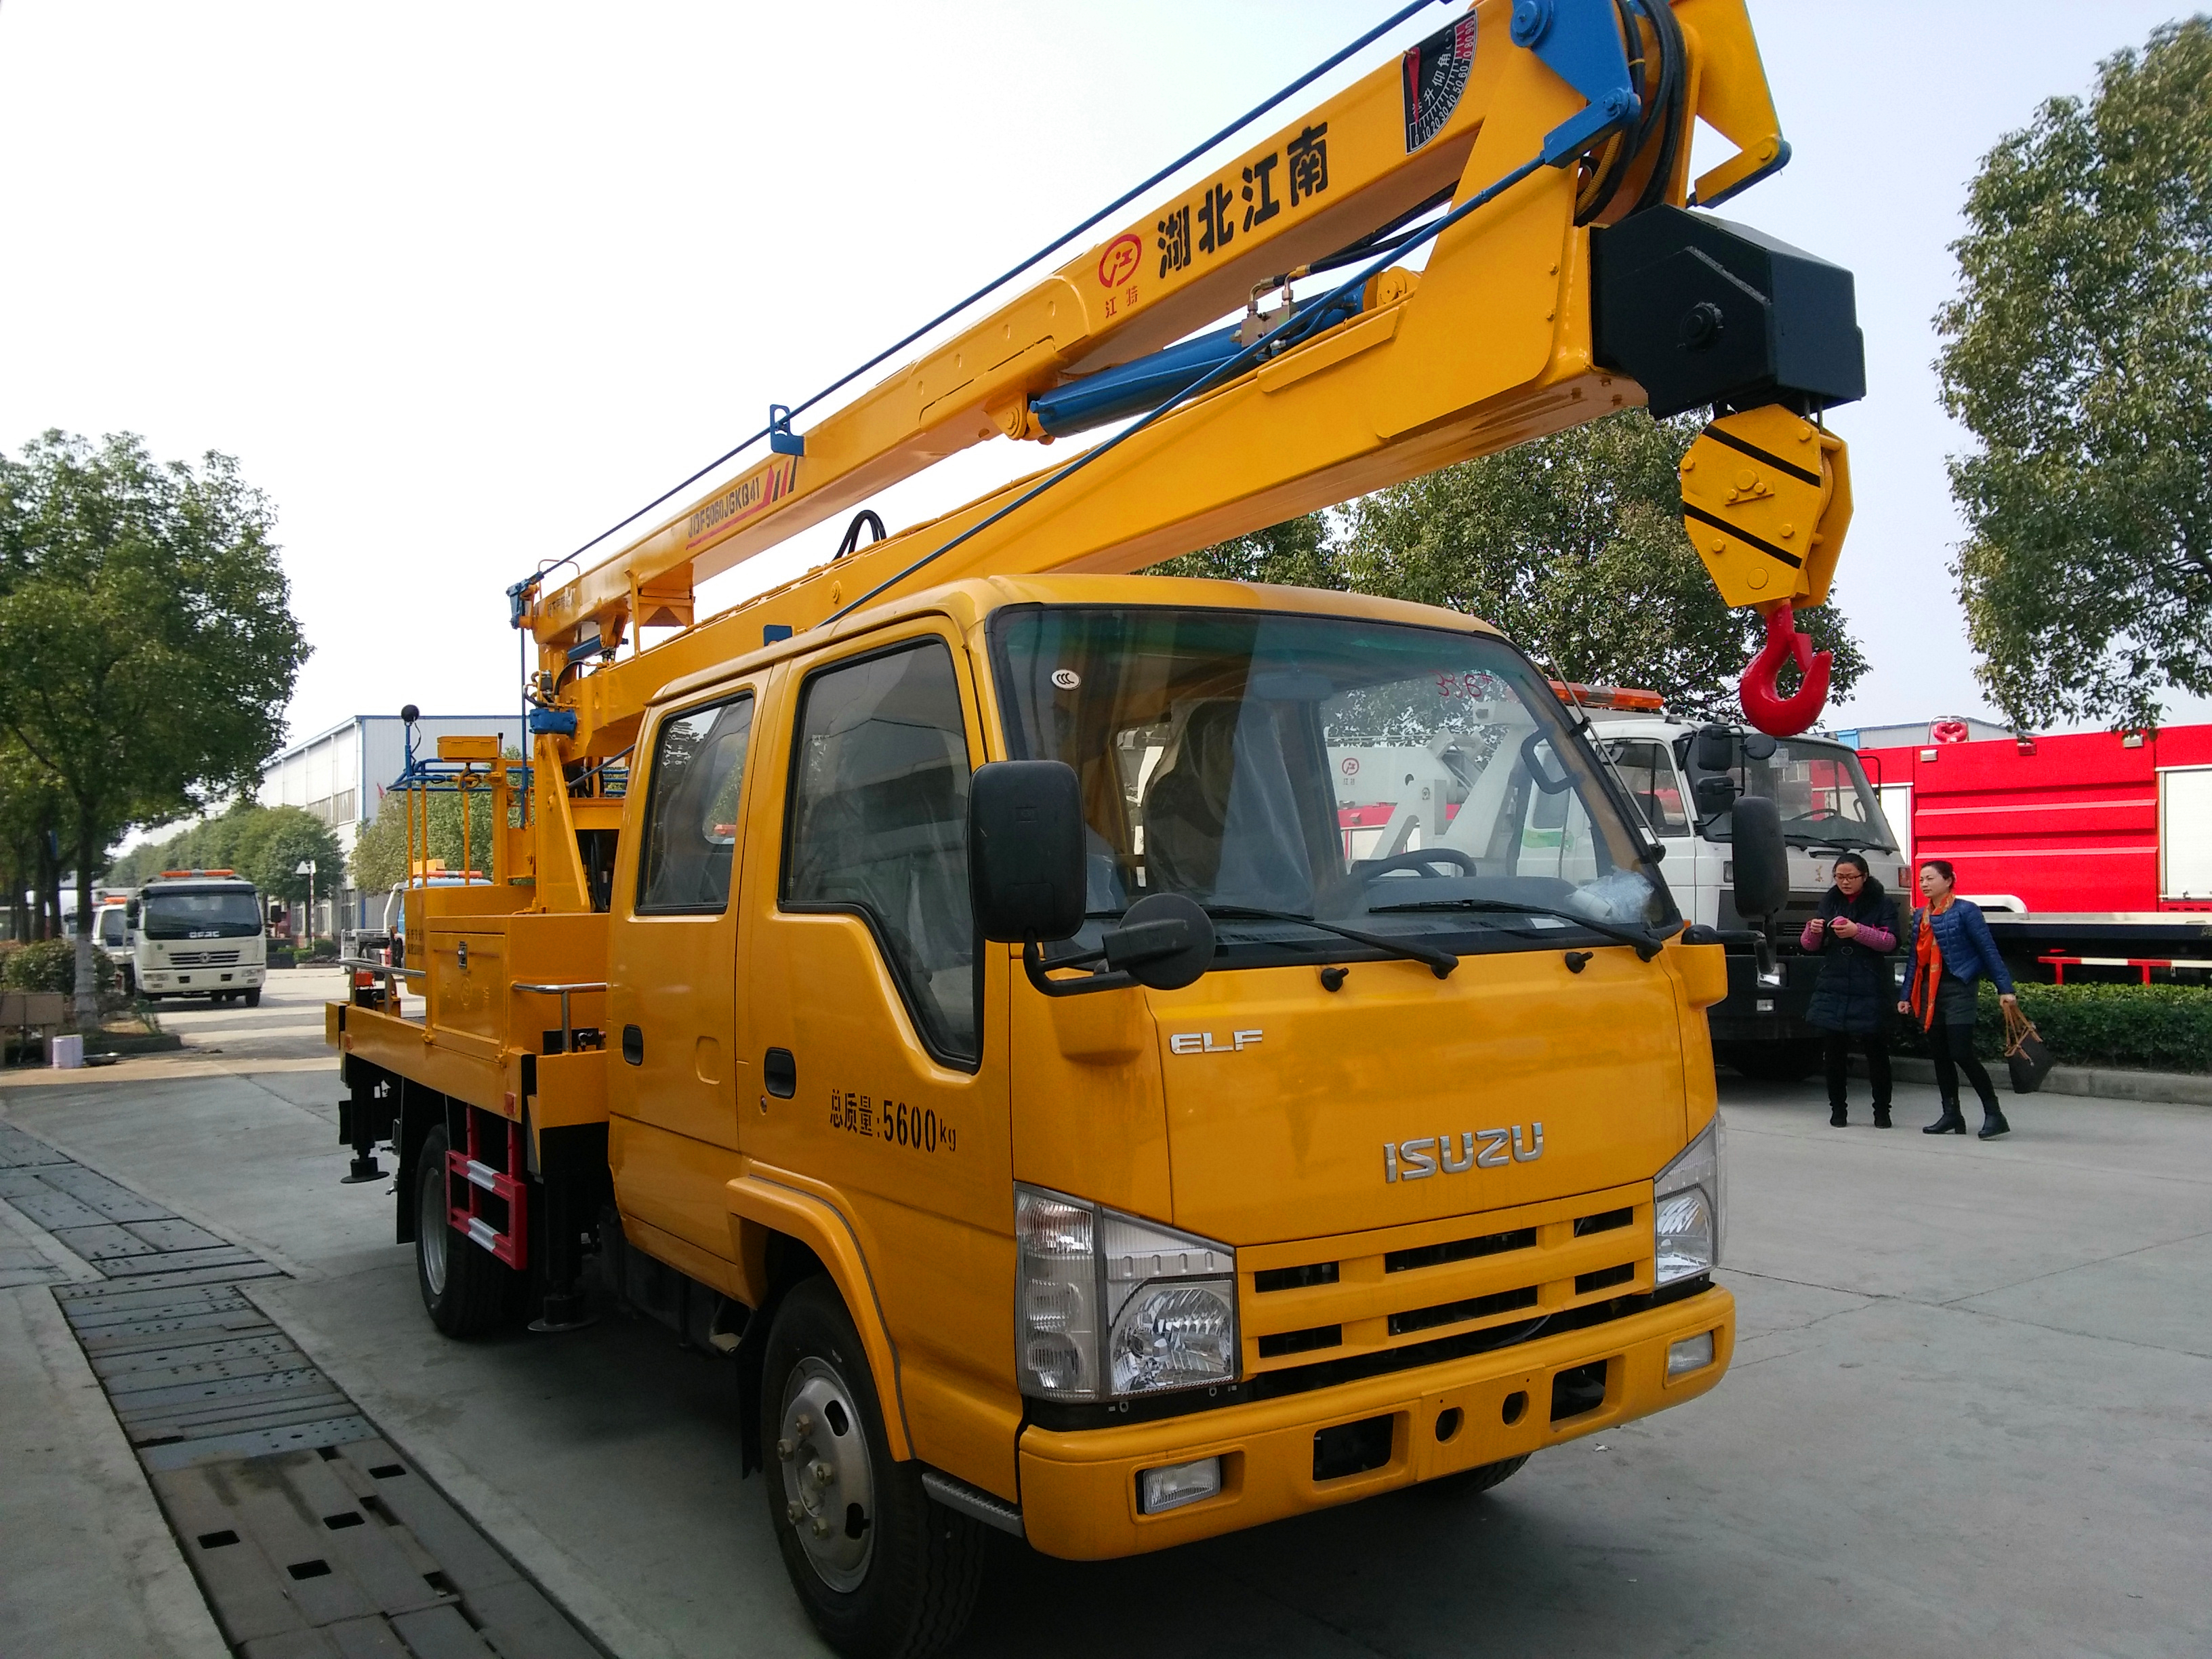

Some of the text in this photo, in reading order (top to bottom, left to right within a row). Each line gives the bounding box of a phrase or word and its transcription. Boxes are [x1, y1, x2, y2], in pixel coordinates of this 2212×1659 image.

[1465, 20, 1475, 35] 90
[1464, 35, 1474, 49] 80
[1462, 51, 1473, 64] 70
[1458, 65, 1469, 79] 60
[1453, 80, 1464, 94] 50
[1446, 94, 1456, 109] 40
[1439, 106, 1449, 121] 30
[1431, 117, 1441, 132] 20
[1414, 134, 1420, 146] 0
[1422, 125, 1431, 140] 10
[1158, 121, 1328, 279] 湖北江南
[1170, 1029, 1263, 1055] ELF
[1384, 1122, 1544, 1184] ISUZU
